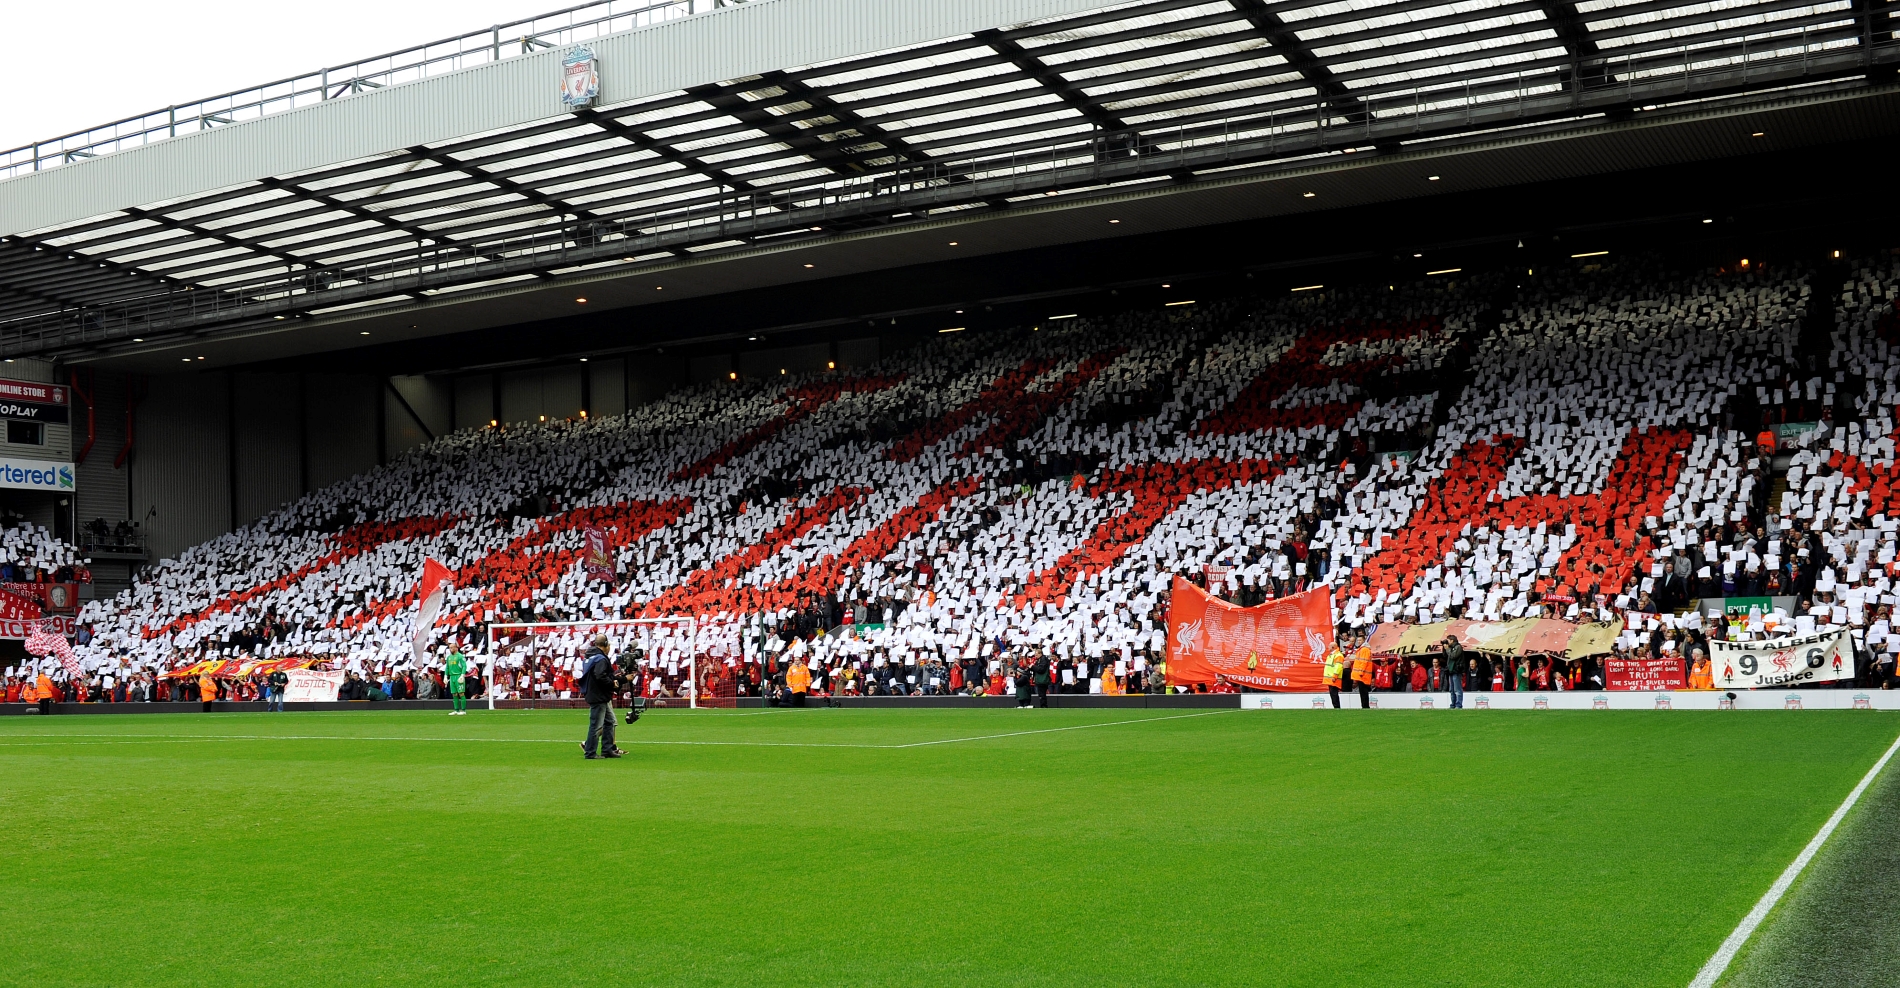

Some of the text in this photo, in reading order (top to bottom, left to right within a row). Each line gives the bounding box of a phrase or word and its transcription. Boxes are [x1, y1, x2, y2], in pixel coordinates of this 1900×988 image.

[23, 386, 46, 398] STORE
[1781, 428, 1798, 436] EXIT
[30, 582, 37, 590] is
[1727, 605, 1748, 613] EXIT
[53, 615, 76, 635] 96
[1713, 628, 1847, 652] THE ALBERT
[1739, 647, 1826, 676] 9 6
[1629, 672, 1659, 680] TRUTH
[1755, 670, 1814, 685] Justice
[295, 679, 327, 688] JUSTICE
[1275, 677, 1290, 687] FC
